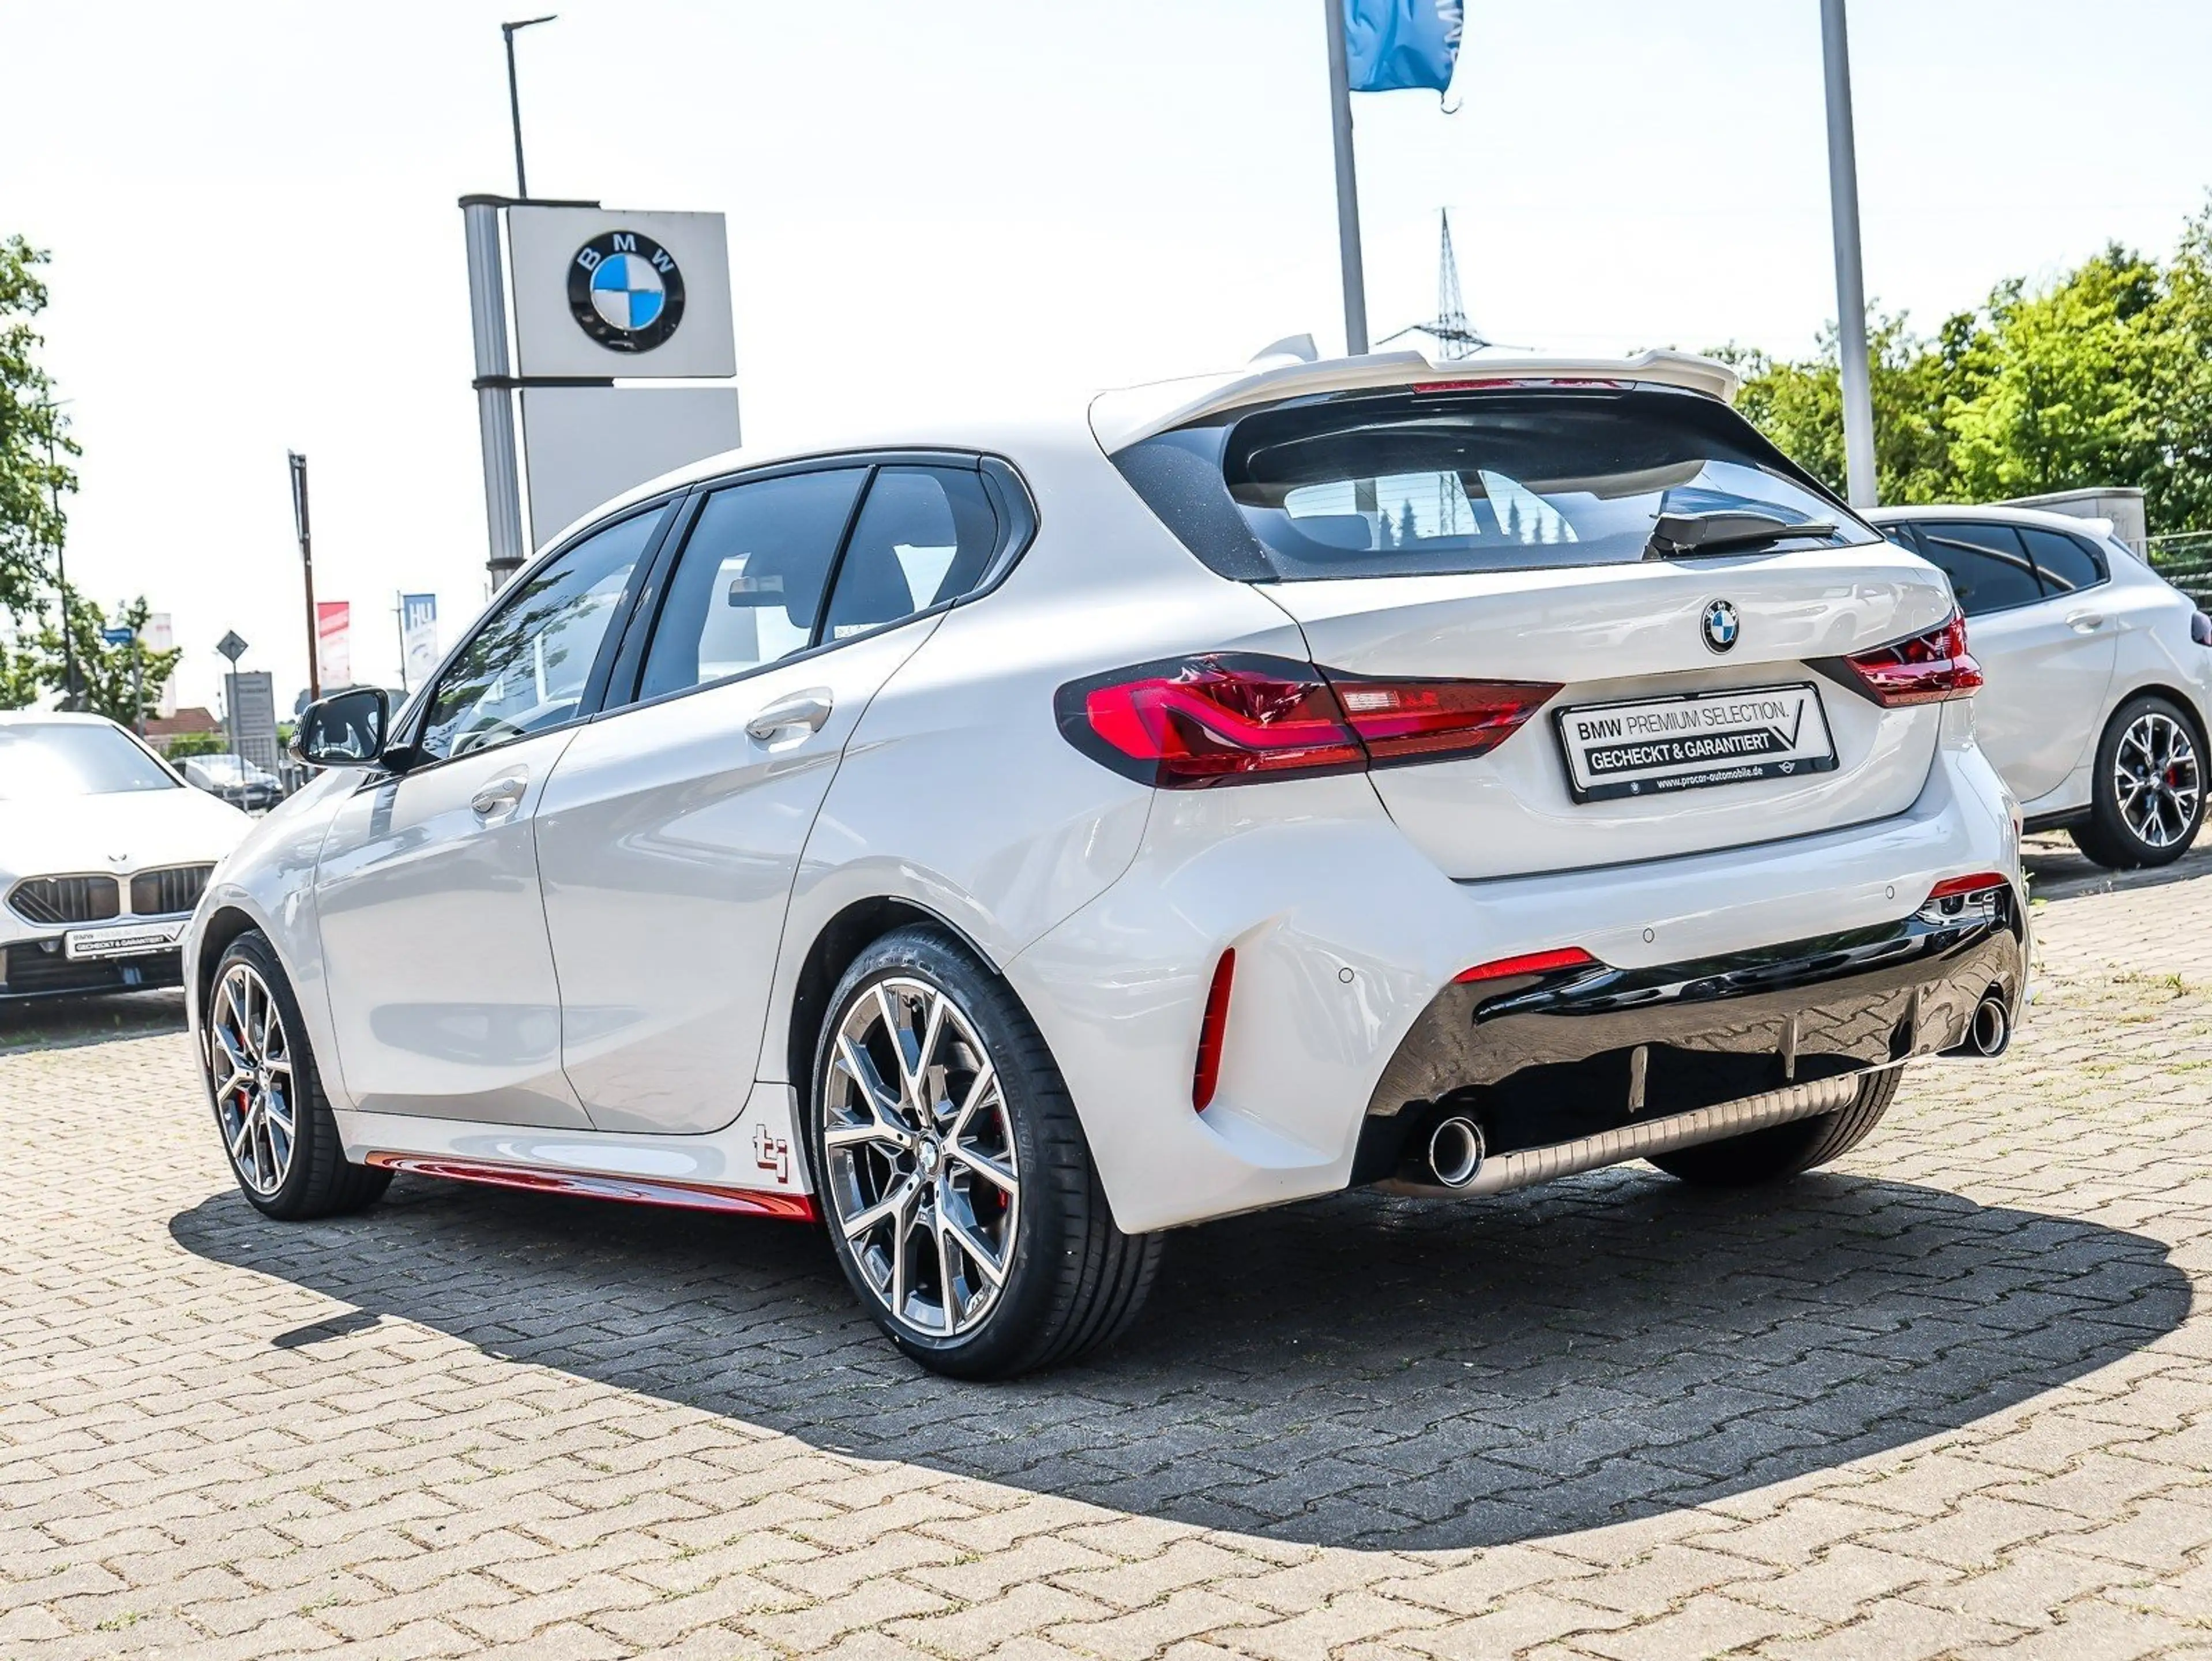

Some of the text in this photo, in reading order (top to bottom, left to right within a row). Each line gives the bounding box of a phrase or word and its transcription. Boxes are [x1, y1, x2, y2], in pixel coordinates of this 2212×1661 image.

[577, 234, 674, 273] BMW
[1706, 602, 1738, 622] BMW
[1577, 701, 1789, 741] BMW PREMIUM SELECTION.
[1591, 732, 1769, 770] GECHECKT & GARANTIERT
[1657, 766, 1763, 788] www.procar-automobile.de
